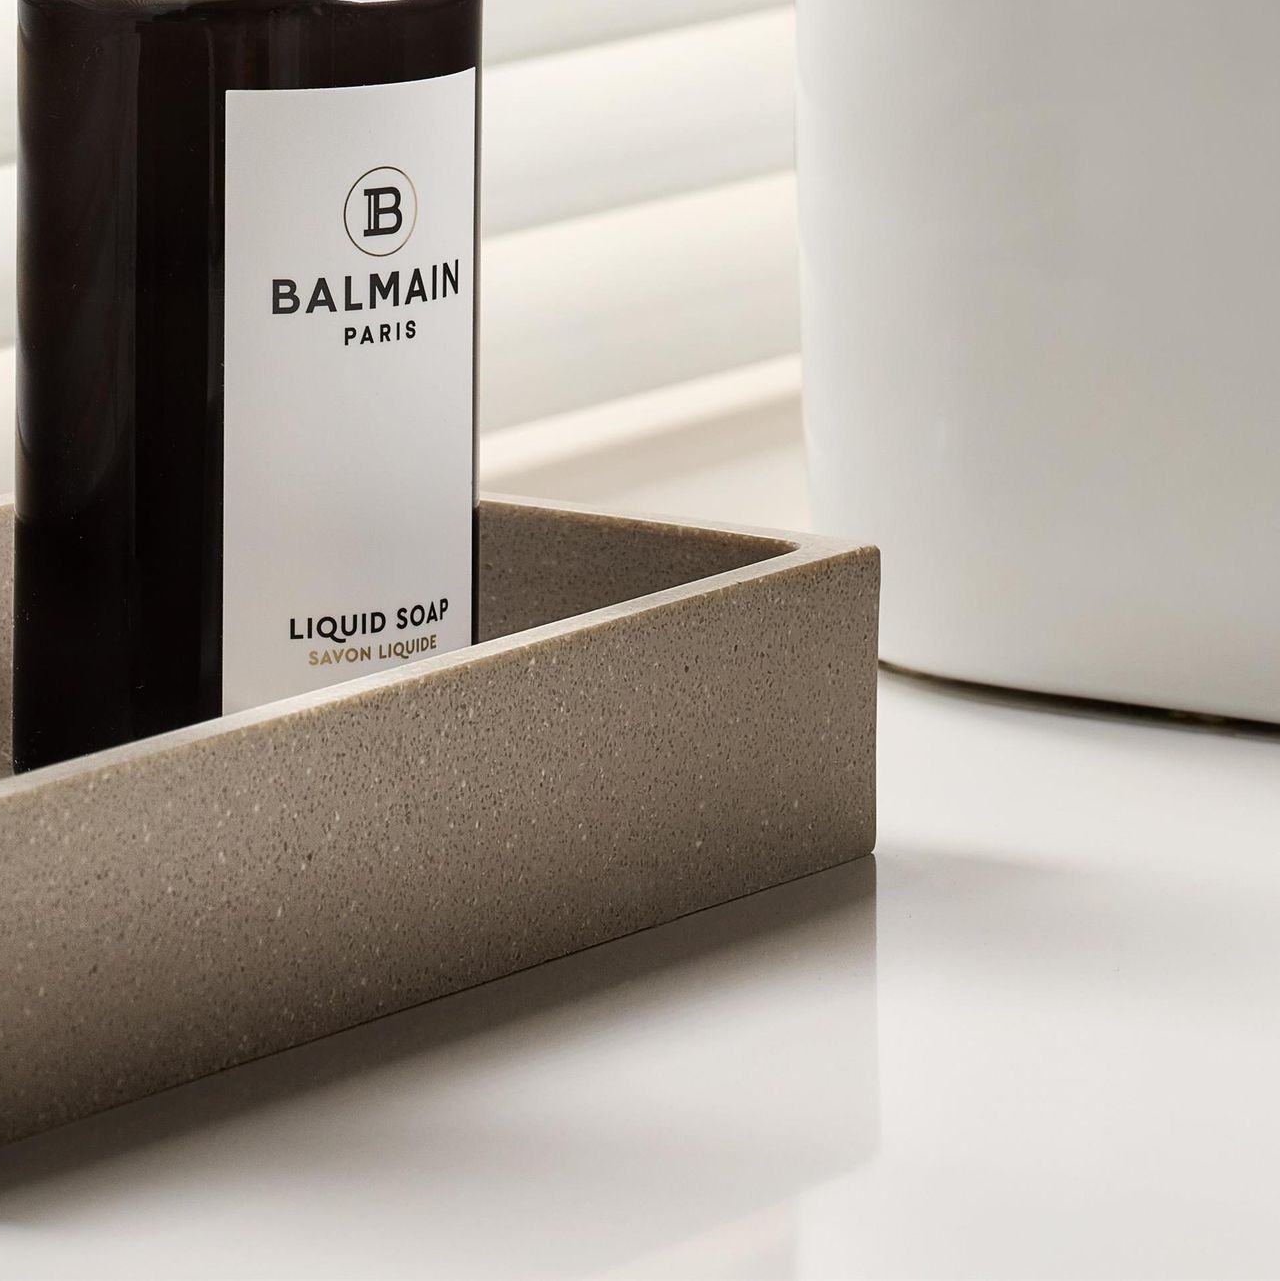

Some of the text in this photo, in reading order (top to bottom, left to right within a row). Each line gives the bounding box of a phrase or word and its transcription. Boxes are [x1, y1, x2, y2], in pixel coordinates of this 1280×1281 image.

[271, 259, 460, 315] BALMAIN
[344, 320, 417, 346] PARIS
[289, 598, 449, 644] LIQUID SOAP
[308, 634, 437, 666] SAVON LIQUIDE
